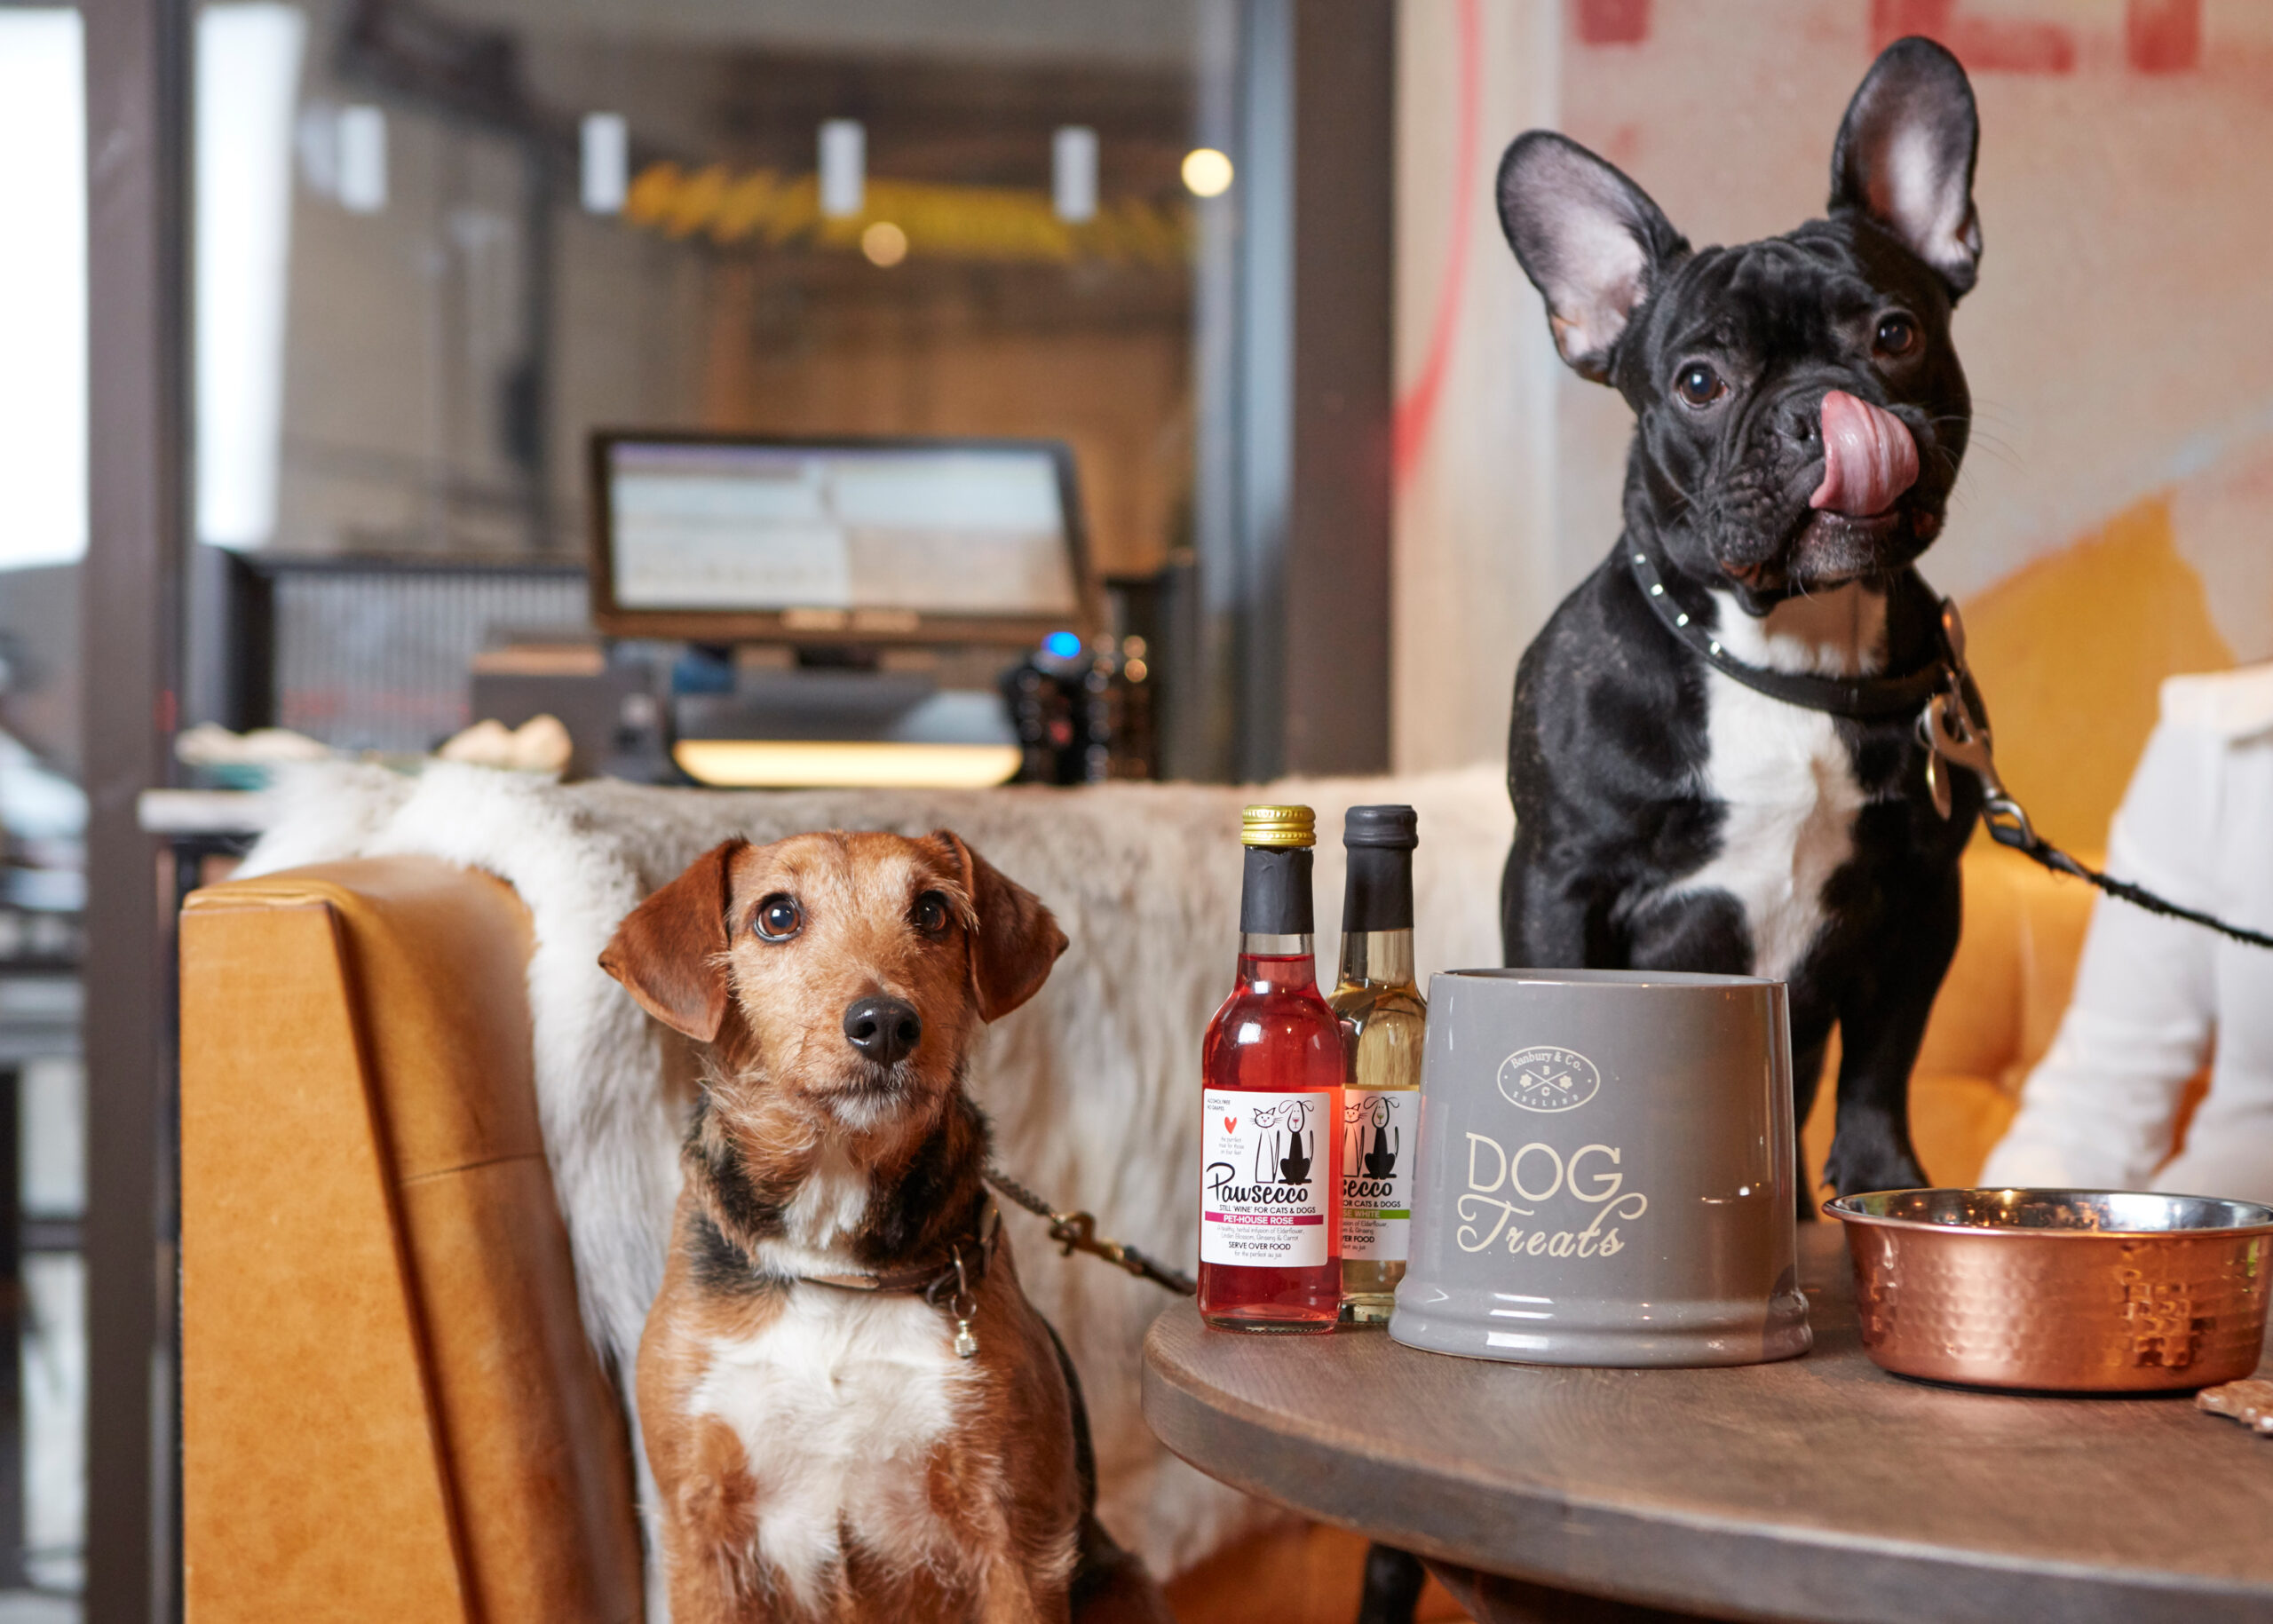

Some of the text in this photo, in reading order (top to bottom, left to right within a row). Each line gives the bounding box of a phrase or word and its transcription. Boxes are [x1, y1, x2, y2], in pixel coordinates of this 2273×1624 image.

[1511, 1051, 1581, 1071] Banbury & Co.
[1542, 1066, 1550, 1075] B
[1513, 1091, 1579, 1106] ENGLAND
[1541, 1087, 1550, 1097] C
[1466, 1131, 1623, 1202] DOG
[1206, 1162, 1309, 1204] Pawsecco
[1224, 1215, 1269, 1224] PET-HOUSE
[1457, 1192, 1648, 1258] Treats
